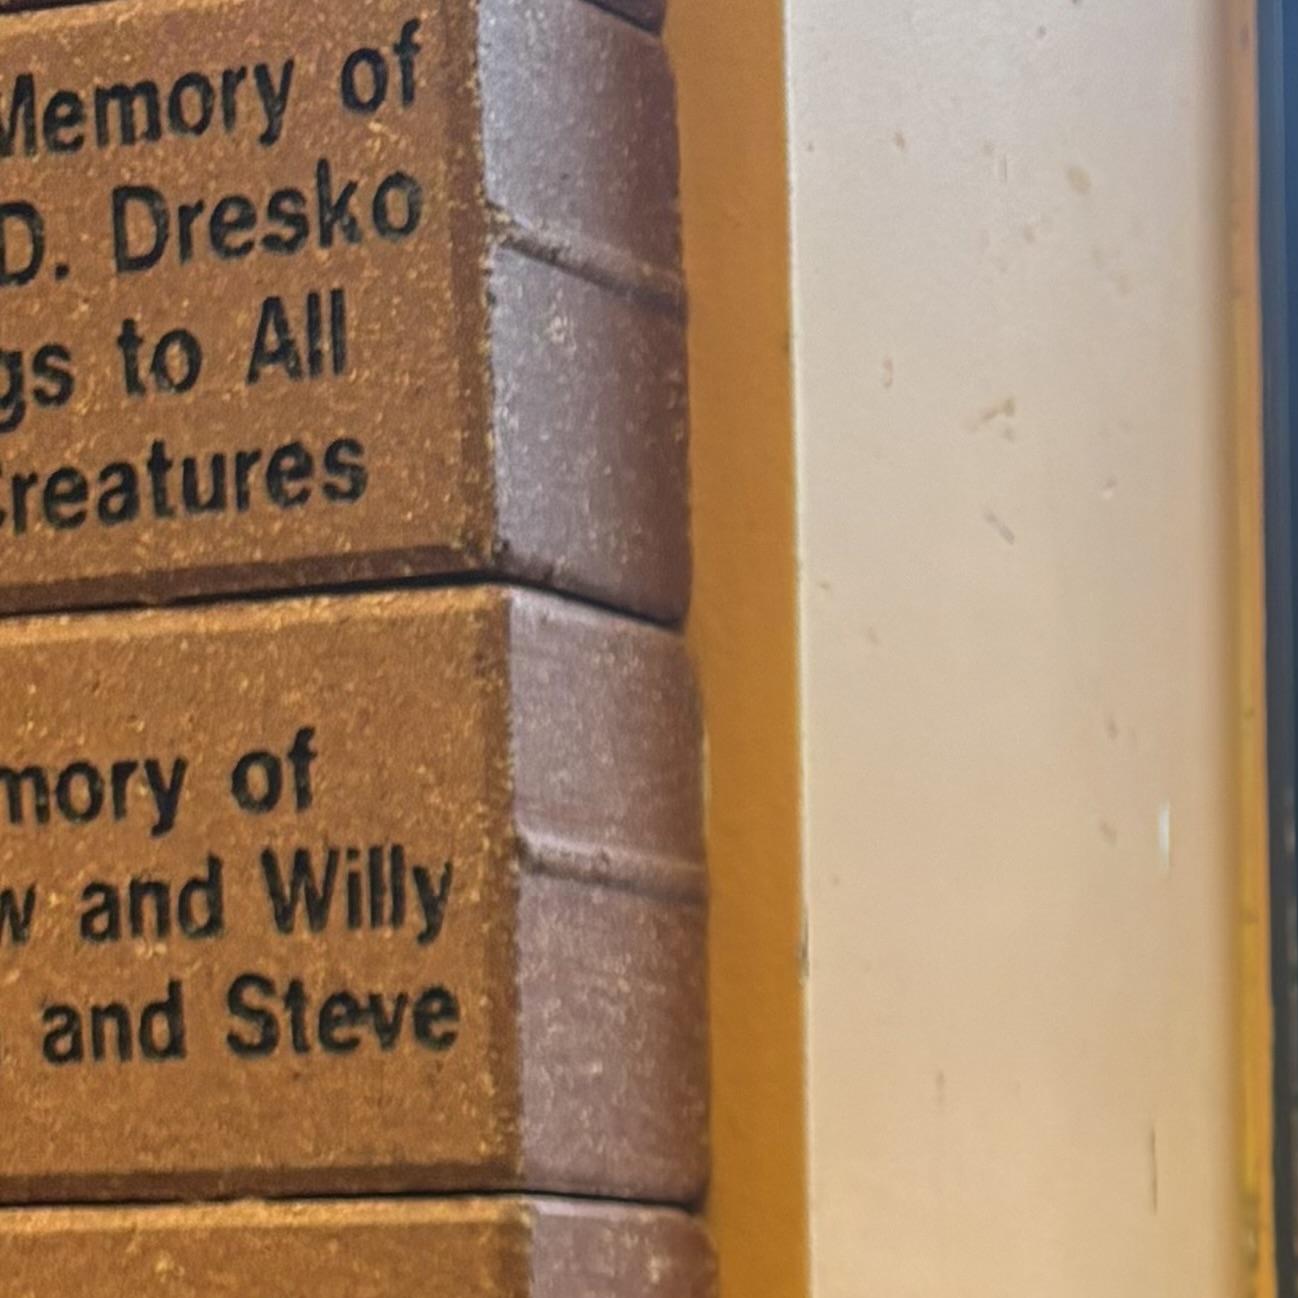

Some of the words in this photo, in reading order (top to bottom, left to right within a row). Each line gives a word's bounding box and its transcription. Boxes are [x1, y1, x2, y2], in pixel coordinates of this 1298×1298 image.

[340, 18, 421, 115] of
[111, 158, 422, 274] Dresko
[116, 319, 202, 396] to
[247, 288, 346, 384] All
[0, 438, 367, 535] reatures
[231, 727, 317, 814] of
[80, 853, 224, 943] and
[260, 844, 452, 945] Willy
[42, 979, 185, 1065] and
[226, 973, 458, 1058] Steve
